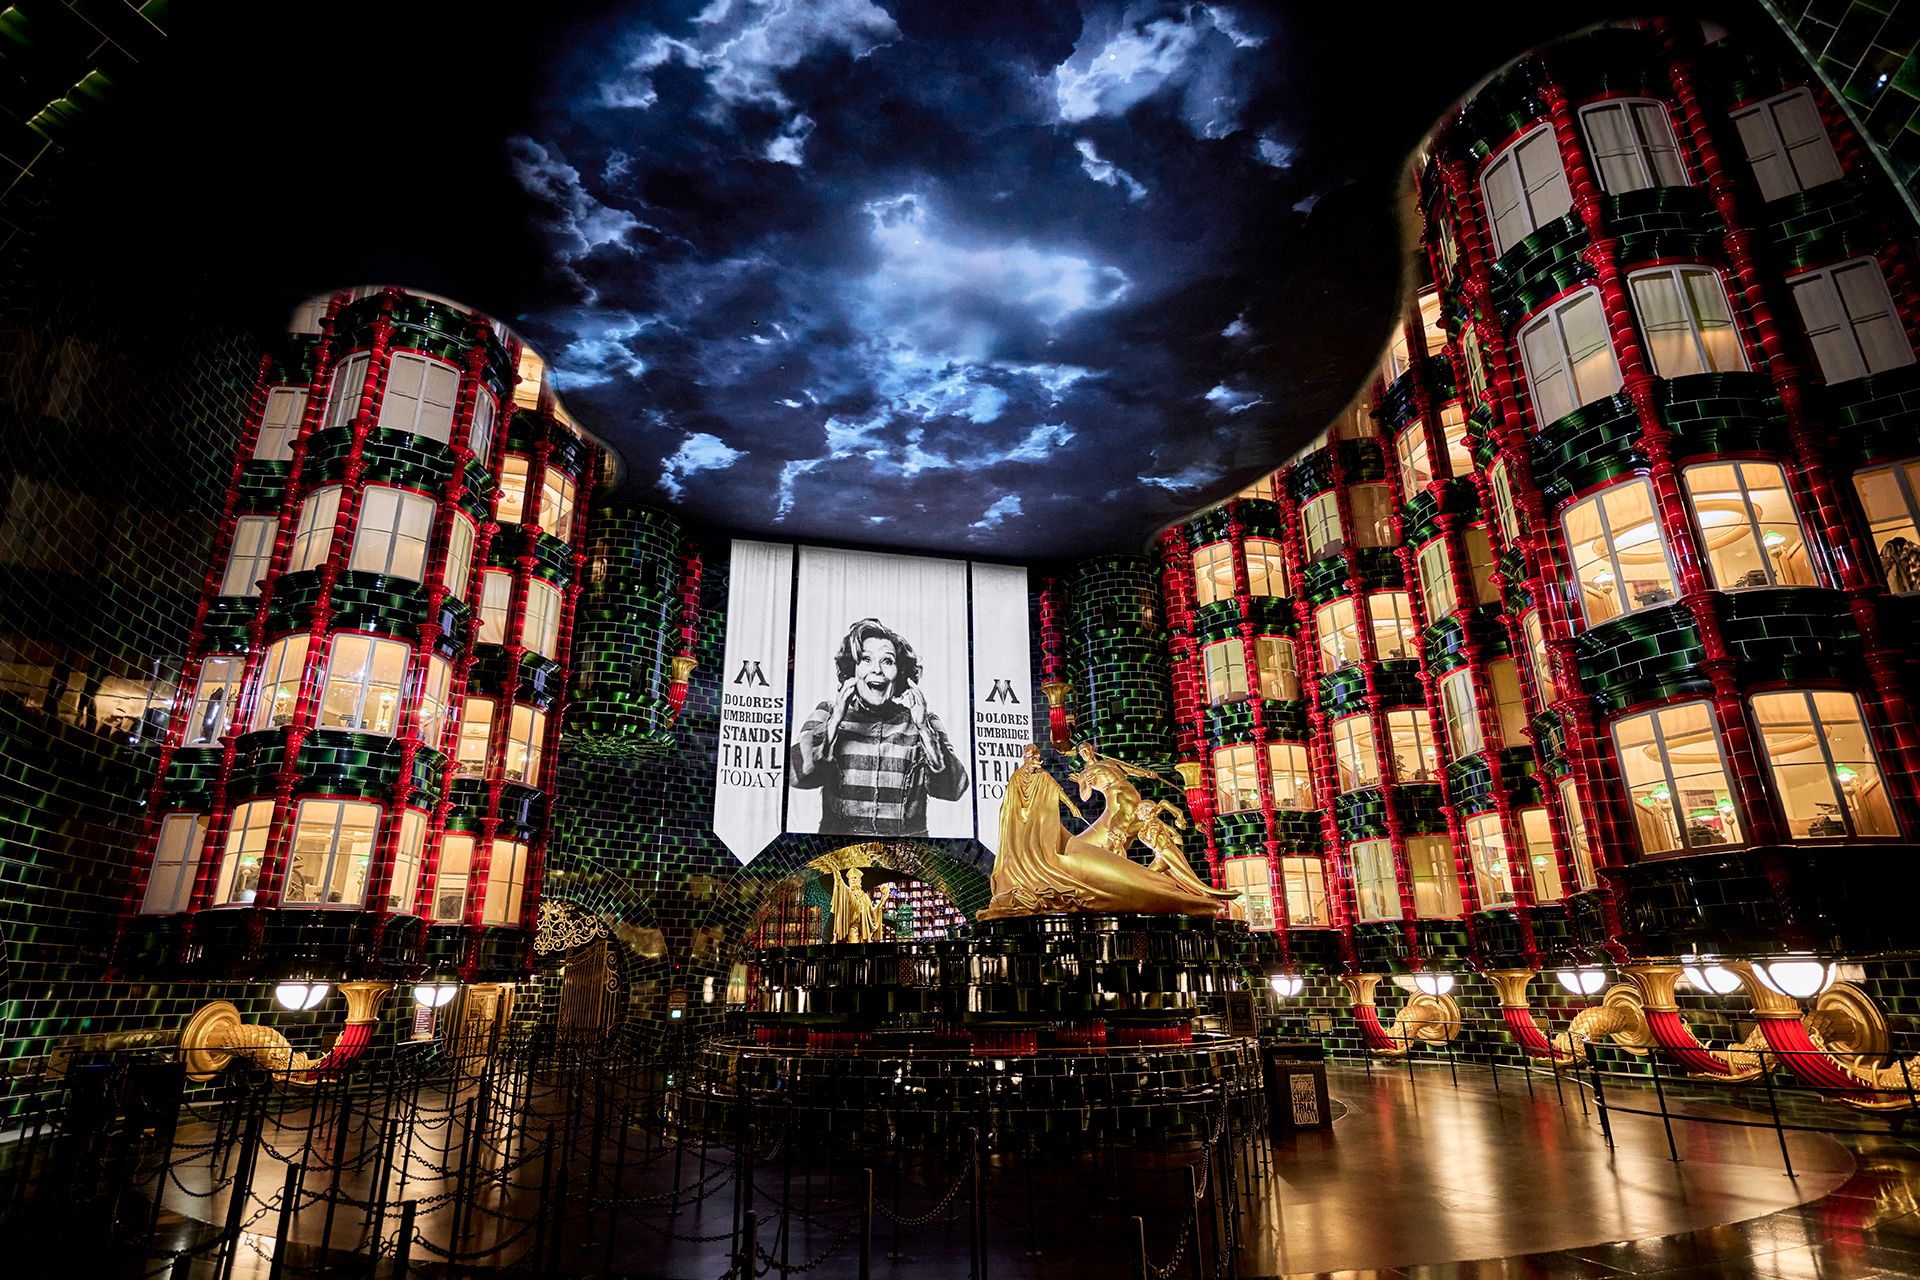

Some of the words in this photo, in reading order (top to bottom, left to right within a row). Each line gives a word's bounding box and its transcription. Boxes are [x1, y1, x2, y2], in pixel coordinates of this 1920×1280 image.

[724, 693, 784, 709] DOLORES
[723, 709, 783, 724] UMBRIDGE
[976, 711, 1029, 726] DOLORES
[723, 725, 783, 743] STANDS
[976, 726, 1030, 740] UMBRIDGE
[723, 743, 782, 769] TRIAL
[977, 741, 1027, 758] STAND
[720, 769, 782, 788] TODAY
[979, 760, 1019, 782] TRI
[1294, 1102, 1316, 1113] TRIAL
